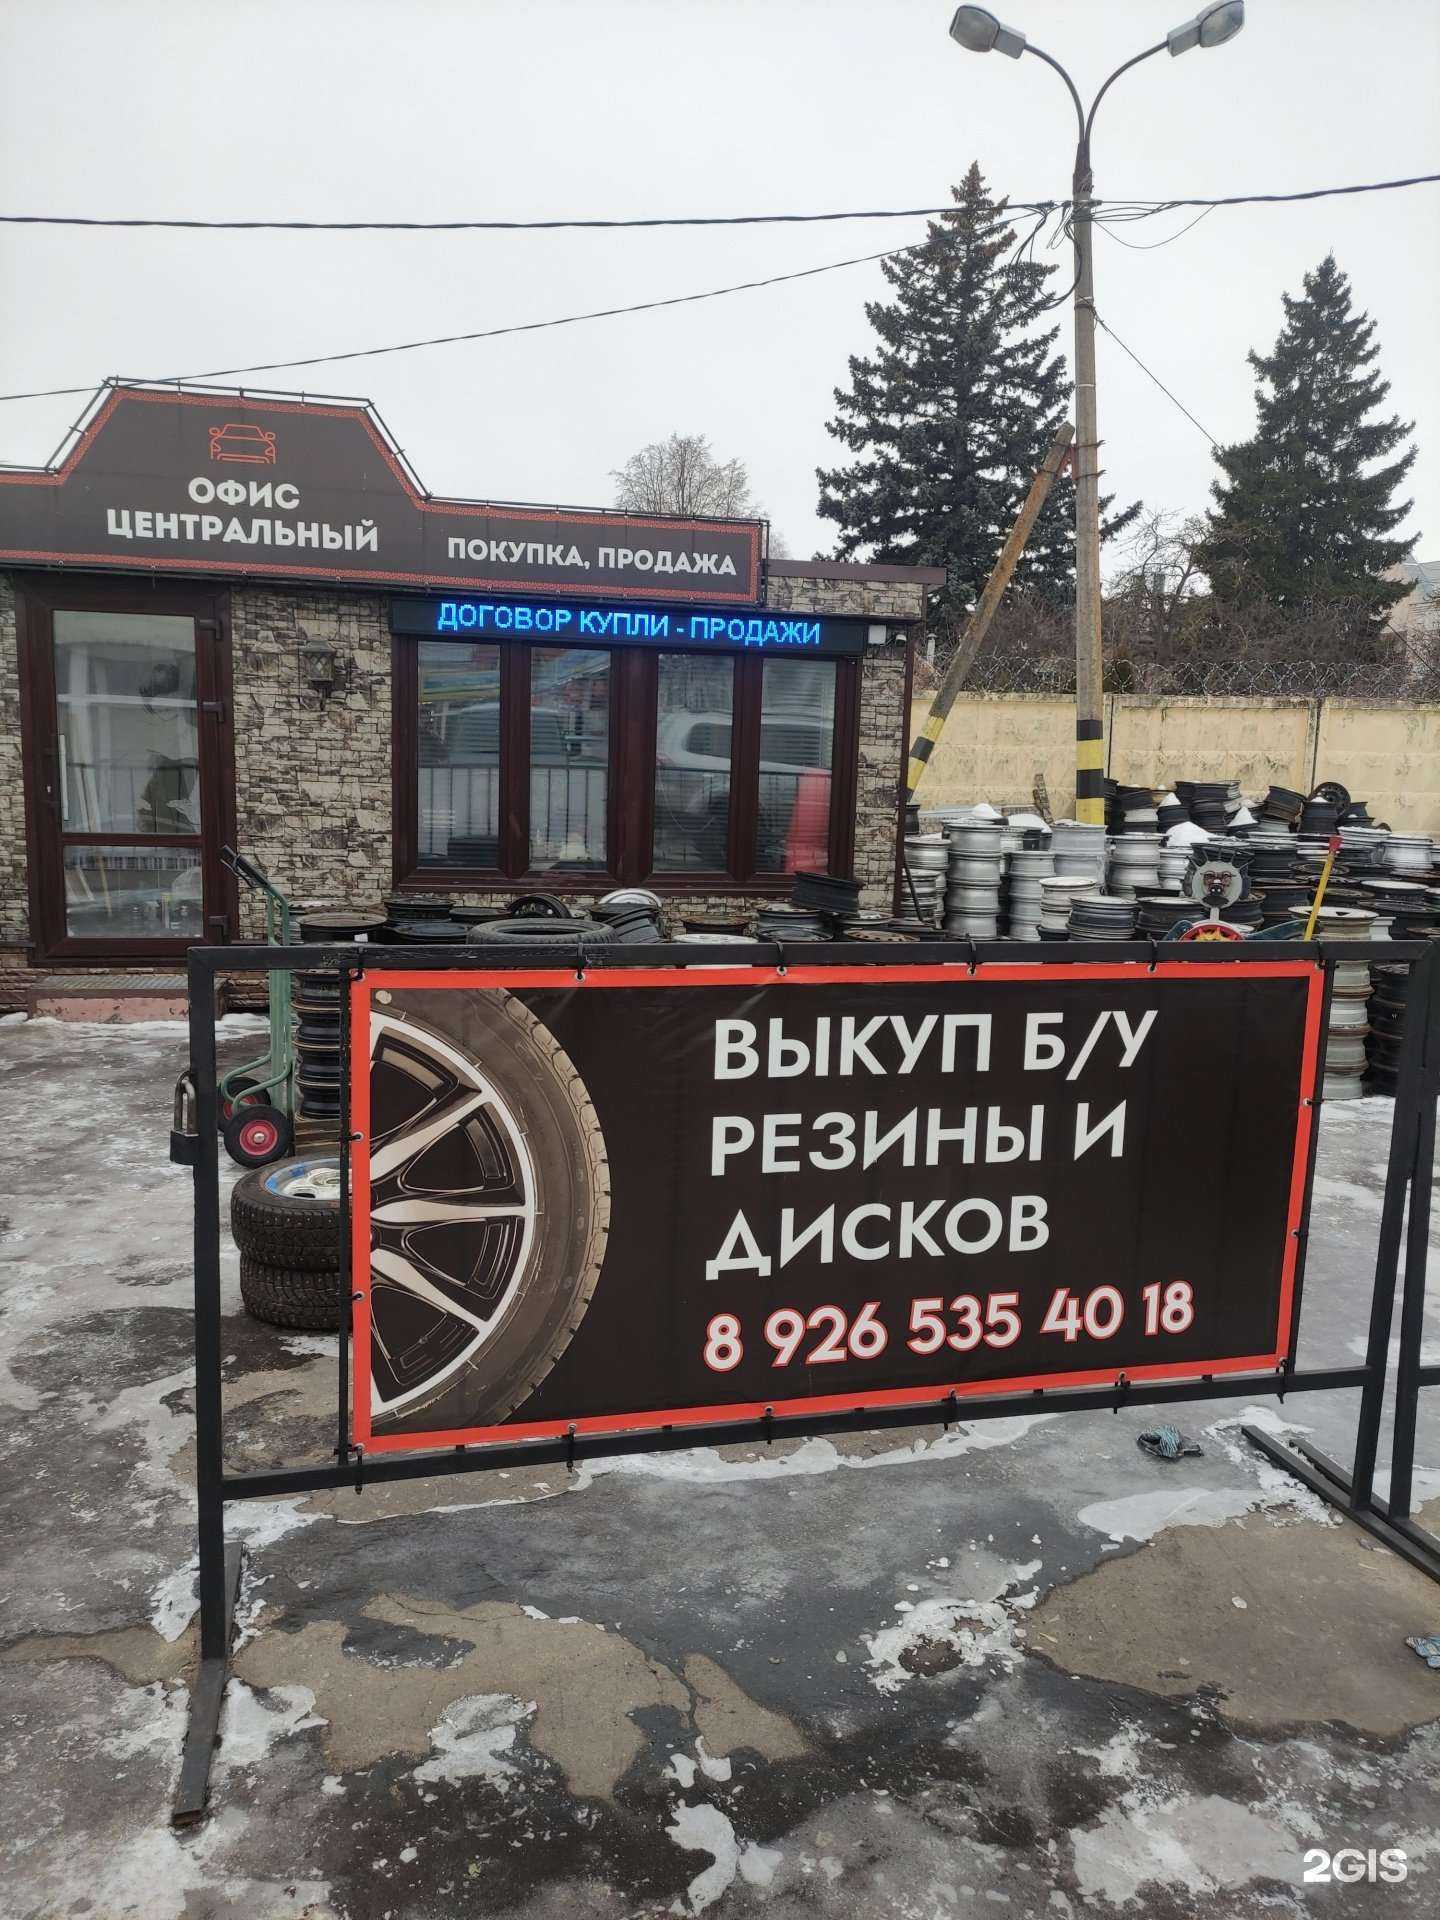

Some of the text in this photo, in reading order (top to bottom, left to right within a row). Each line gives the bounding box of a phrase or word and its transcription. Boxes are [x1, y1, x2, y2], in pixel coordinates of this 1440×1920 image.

[188, 477, 300, 509] ОФИС
[107, 509, 378, 551] ЦЕНТРАЛЬНЫЙ
[448, 537, 737, 575] ПОКУПКА, ПРОДАЖА
[438, 602, 572, 632] ДОГОВОР
[580, 610, 668, 637] КУПЛИ
[691, 617, 822, 647] ПРОДАЖИ
[714, 1010, 1158, 1080] ВЫКУП Б/У
[711, 1100, 1127, 1177] РЕЗИНЫ И
[705, 1195, 1050, 1281] ДИСКОВ
[703, 1281, 1195, 1372] 8 926 535 40 18
